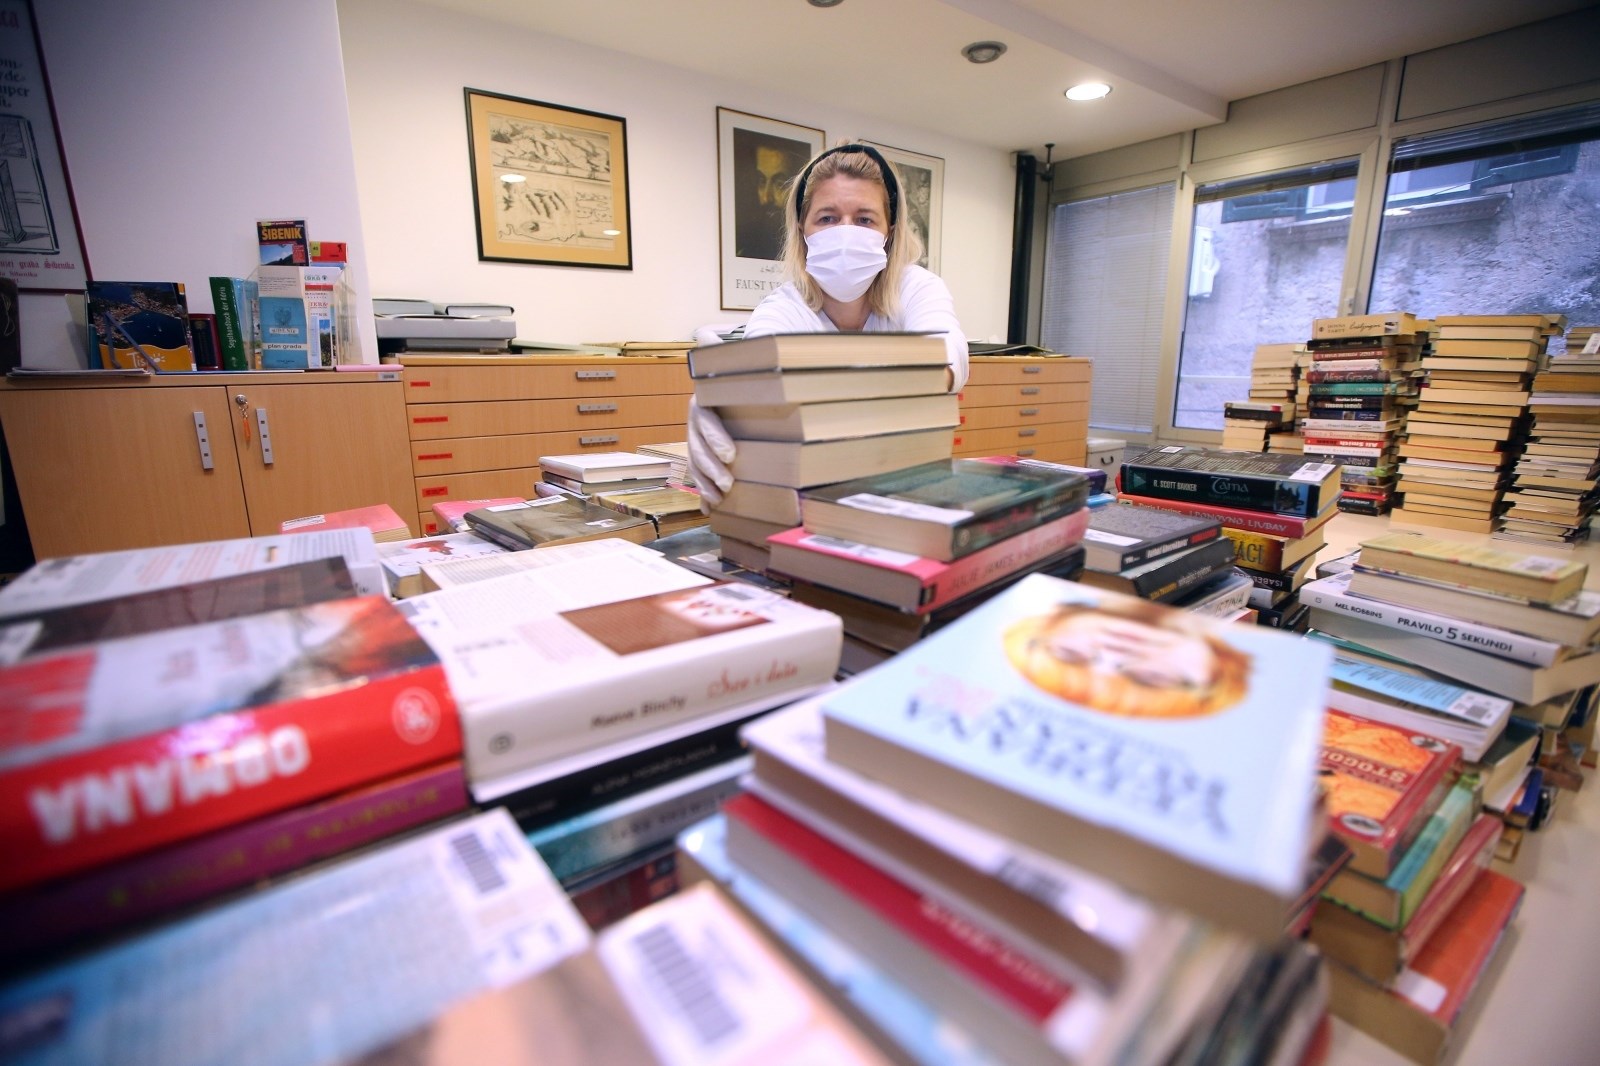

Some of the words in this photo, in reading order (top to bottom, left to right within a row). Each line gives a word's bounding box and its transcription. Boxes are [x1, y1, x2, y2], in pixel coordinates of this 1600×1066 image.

[261, 226, 303, 241] ŠIBENIK
[736, 278, 766, 290] FAUST
[1322, 372, 1345, 382] Alias
[1346, 372, 1374, 383] Grace
[1153, 479, 1159, 488] R.
[1160, 480, 1176, 489] SCOTT
[1248, 518, 1287, 532] LJUBAV
[1334, 602, 1350, 611] MEL
[1351, 606, 1383, 619] ROBBINS
[1397, 616, 1443, 635] PRAVILO
[1446, 626, 1459, 640] 5
[1461, 632, 1513, 653] SEKUNDI
[590, 704, 637, 731] Maeve
[640, 694, 688, 720] Binchy
[30, 724, 312, 845] OBMANA
